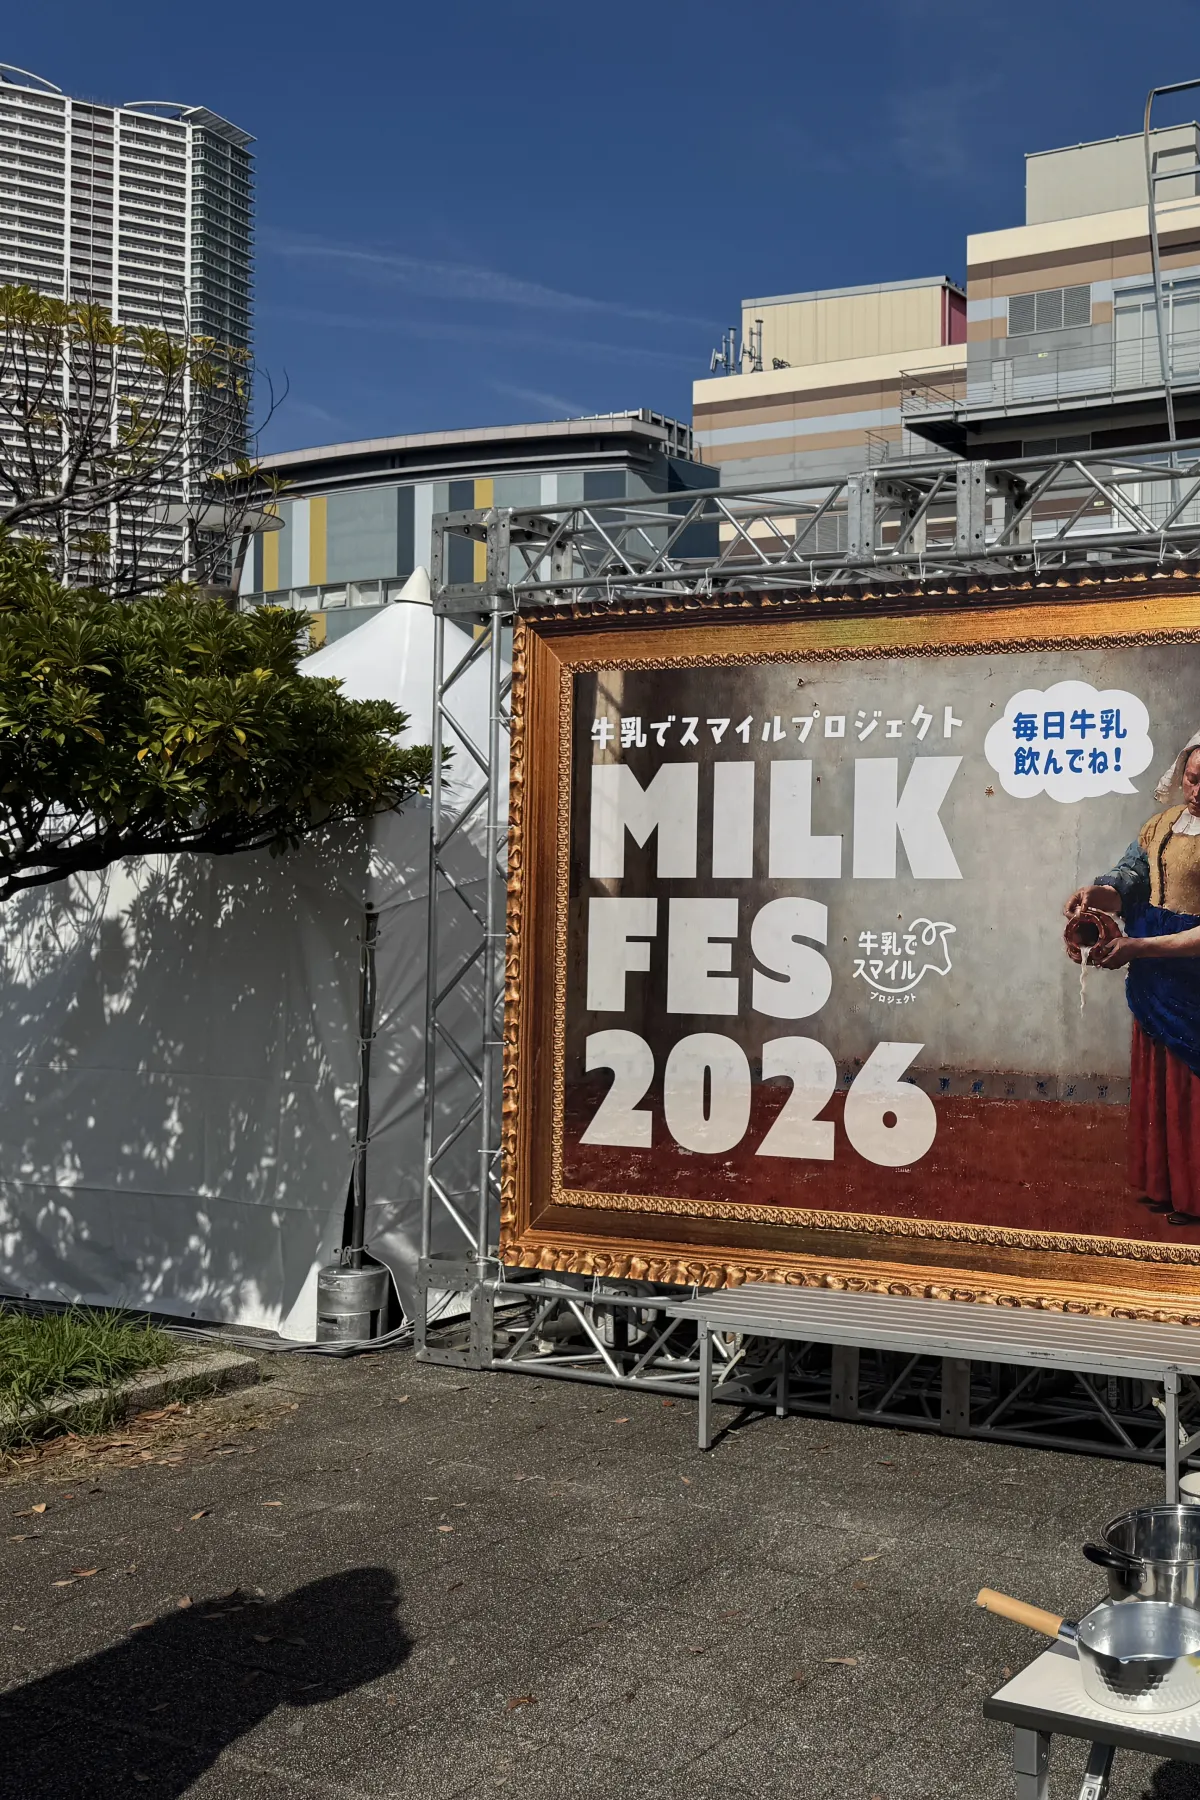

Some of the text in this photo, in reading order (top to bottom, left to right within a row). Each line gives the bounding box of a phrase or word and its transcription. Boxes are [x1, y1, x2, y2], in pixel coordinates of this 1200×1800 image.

[591, 704, 963, 750] 牛乳でスマイルプロジェクト
[1012, 709, 1128, 741] 毎日牛乳
[1014, 746, 1122, 775] 飲んでね!
[589, 756, 964, 880] MILK
[586, 896, 833, 1020] FES
[858, 931, 918, 956] 牛乳で
[852, 959, 917, 981] スマイル
[870, 991, 917, 1004] プロジェクト
[578, 1028, 937, 1168] 2026
